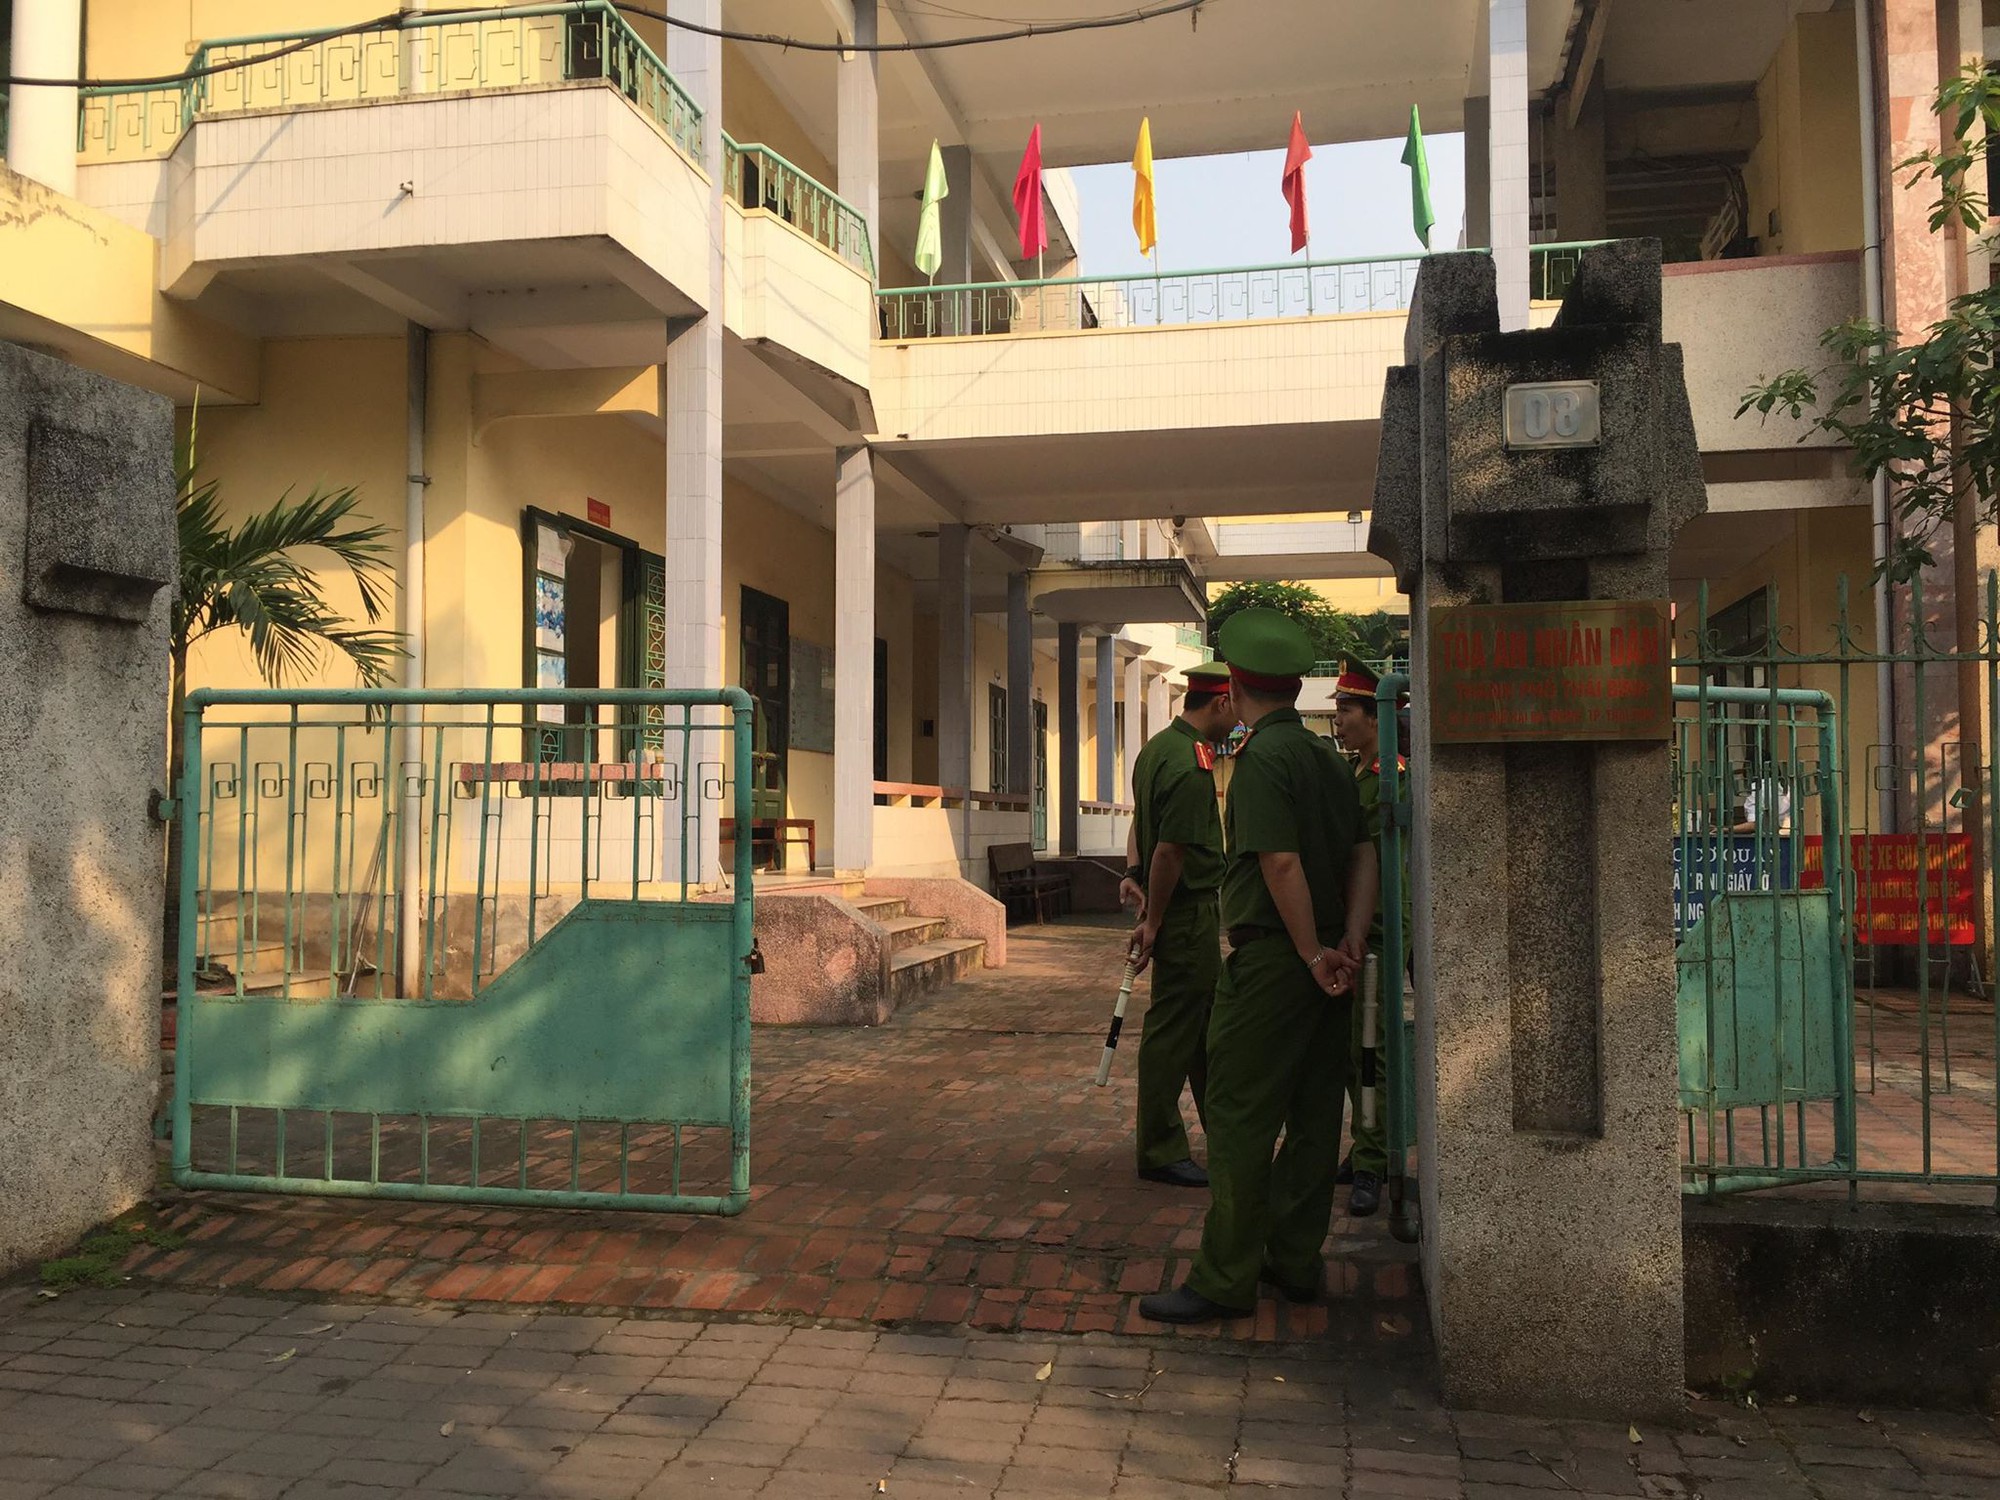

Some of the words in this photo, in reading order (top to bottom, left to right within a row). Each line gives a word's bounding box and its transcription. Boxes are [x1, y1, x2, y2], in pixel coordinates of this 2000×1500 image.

[1535, 619, 1602, 668] NHÂN
[1608, 618, 1659, 668] DÂN
[1877, 844, 1893, 870] XE
